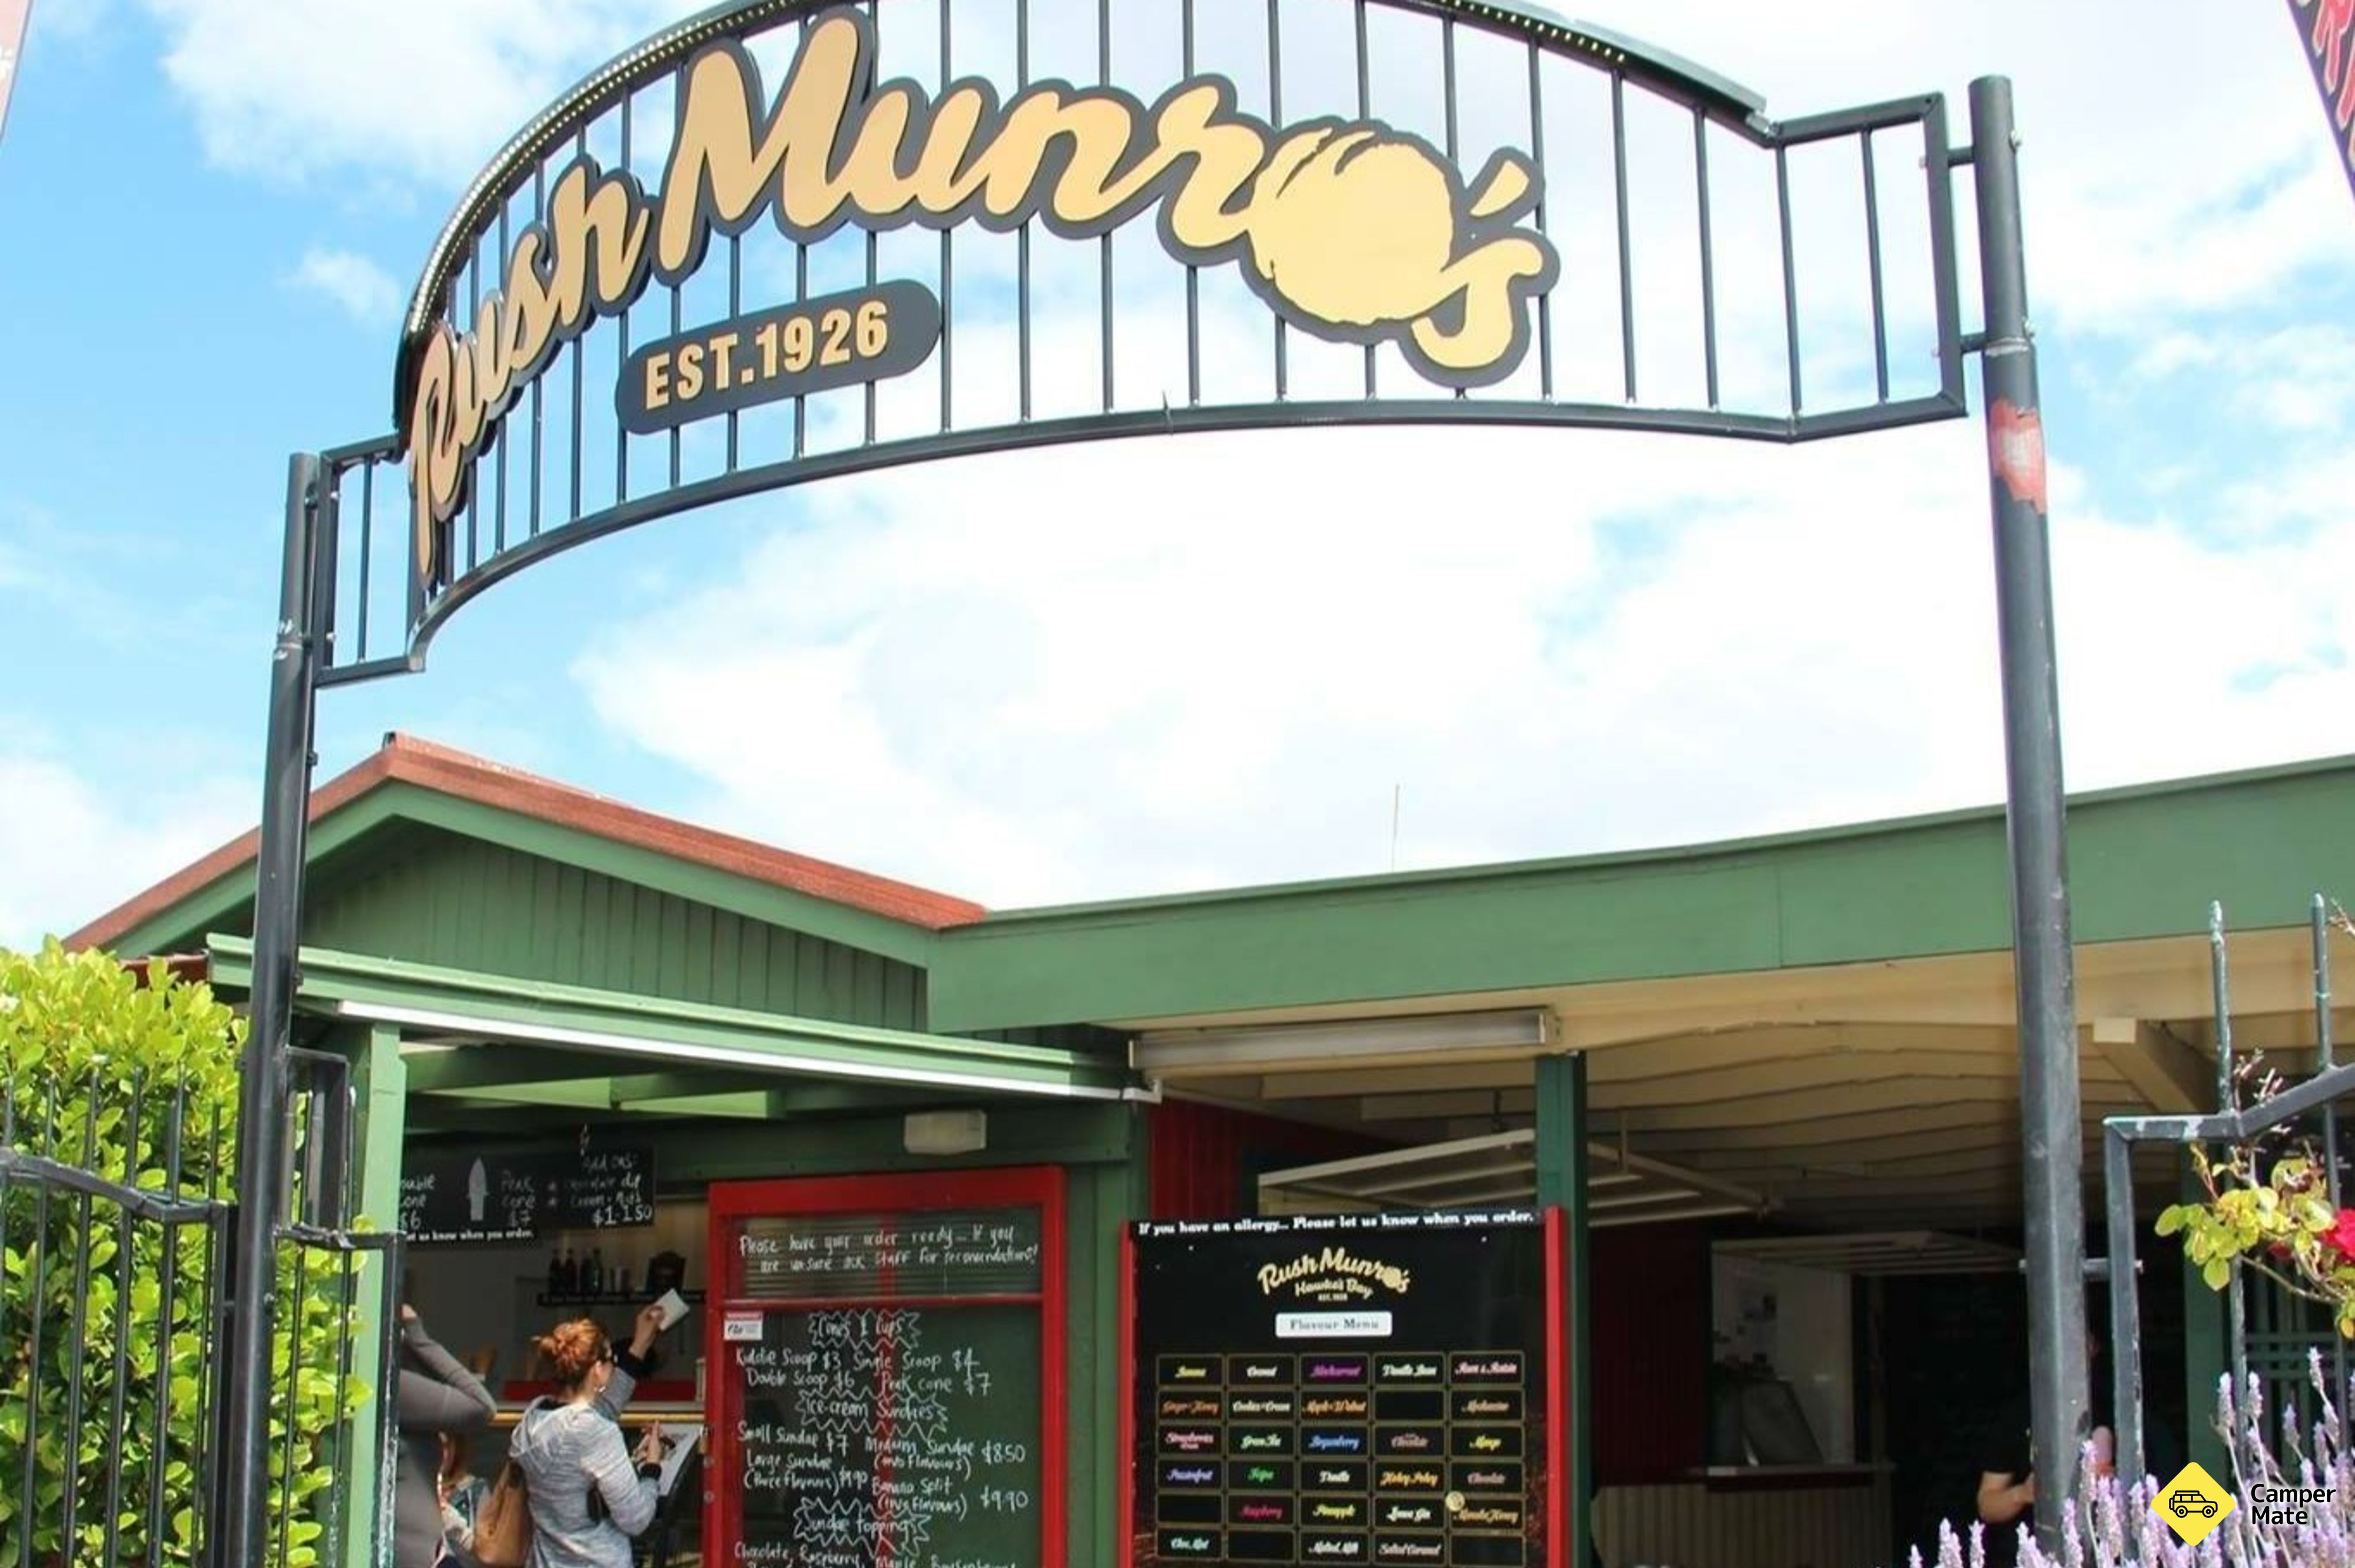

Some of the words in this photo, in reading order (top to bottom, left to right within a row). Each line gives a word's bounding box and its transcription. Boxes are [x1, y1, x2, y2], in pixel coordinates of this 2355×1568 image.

[409, 164, 651, 576] Rush
[658, 16, 1544, 369] Munro's
[432, 1230, 456, 1240] know
[460, 1228, 484, 1240] when
[486, 1231, 503, 1242] you
[1139, 1222, 1151, 1235] If
[1153, 1225, 1175, 1236] you
[1179, 1221, 1208, 1233] have
[1213, 1222, 1230, 1232] an
[1293, 1217, 1335, 1230] Please
[1339, 1215, 1356, 1228] let
[1361, 1217, 1377, 1227] us
[1382, 1213, 1419, 1226] know
[1422, 1211, 1460, 1225] when
[1464, 1214, 1488, 1227] you
[790, 1234, 815, 1251] have
[1257, 1254, 1318, 1295] Rush
[1346, 1278, 1374, 1300] Bay
[1344, 1318, 1379, 1330] Menu
[782, 1347, 818, 1373] Scoop
[903, 1350, 942, 1373] Scoop
[794, 1370, 828, 1391] Scoop
[833, 1370, 855, 1391] $6
[964, 1372, 993, 1396] $7
